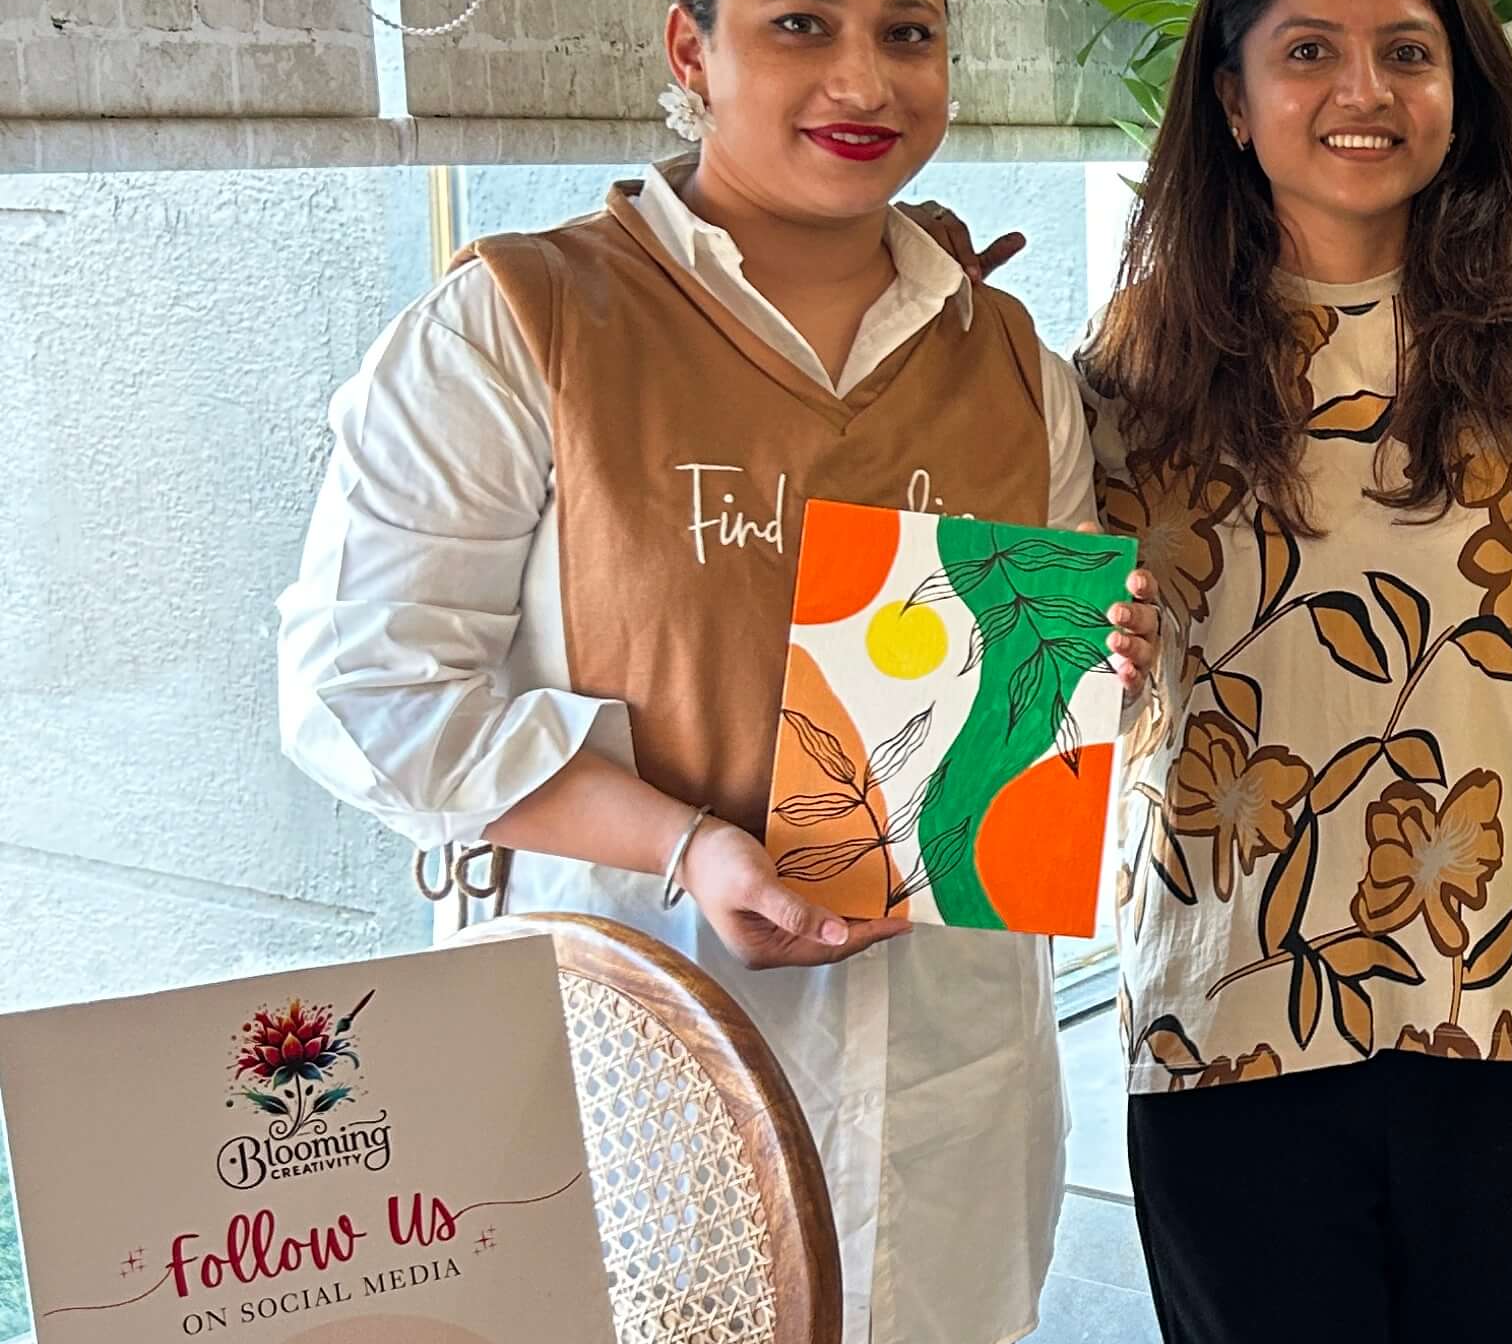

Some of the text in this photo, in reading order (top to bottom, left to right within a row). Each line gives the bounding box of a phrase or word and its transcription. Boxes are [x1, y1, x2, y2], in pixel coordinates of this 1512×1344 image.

[674, 462, 786, 565] Find
[216, 1122, 392, 1190] Blooming
[270, 1153, 362, 1180] CREATIVITY
[165, 1192, 457, 1298] Follow Us
[182, 1257, 462, 1336] ON SOCIAL MEDIA
